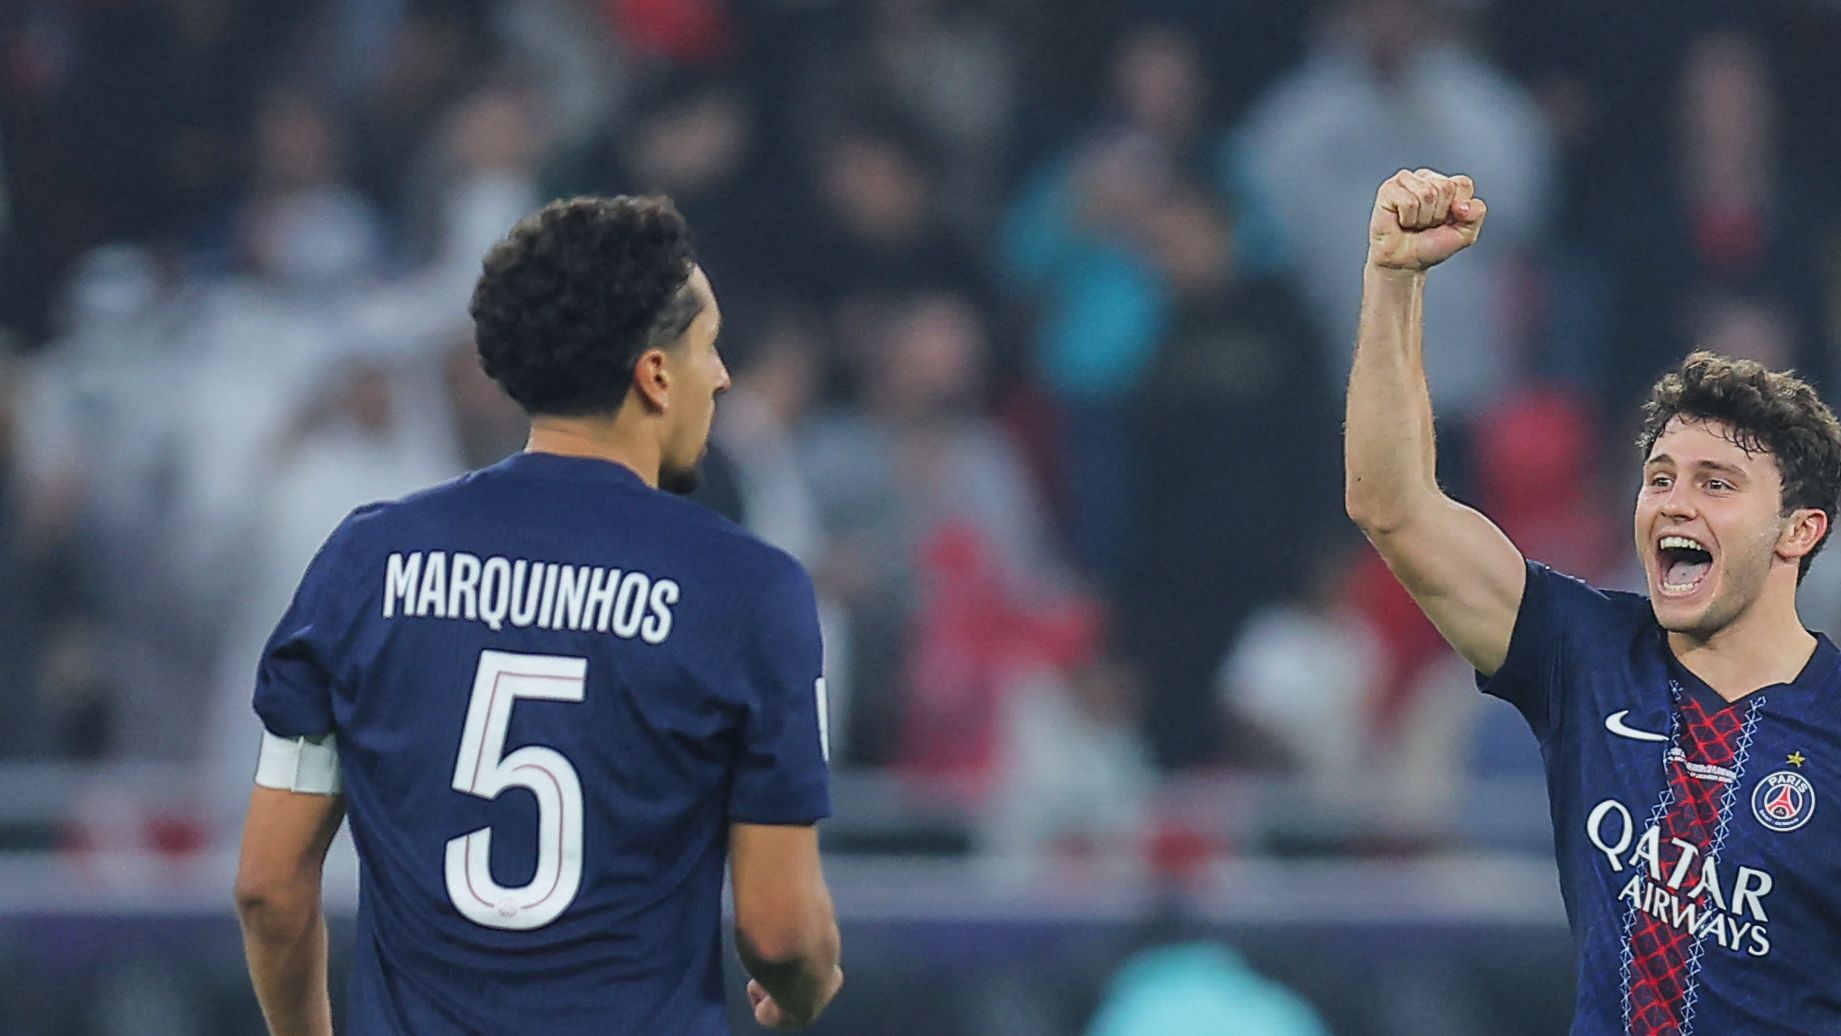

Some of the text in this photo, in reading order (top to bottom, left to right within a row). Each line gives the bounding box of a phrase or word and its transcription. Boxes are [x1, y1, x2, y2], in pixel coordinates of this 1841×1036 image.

[382, 551, 680, 644] MARQUINHOS
[444, 649, 587, 931] 5
[1768, 775, 1808, 793] PARIS
[1587, 799, 1774, 922] QATAR
[1618, 874, 1771, 957] AIRWAYS
